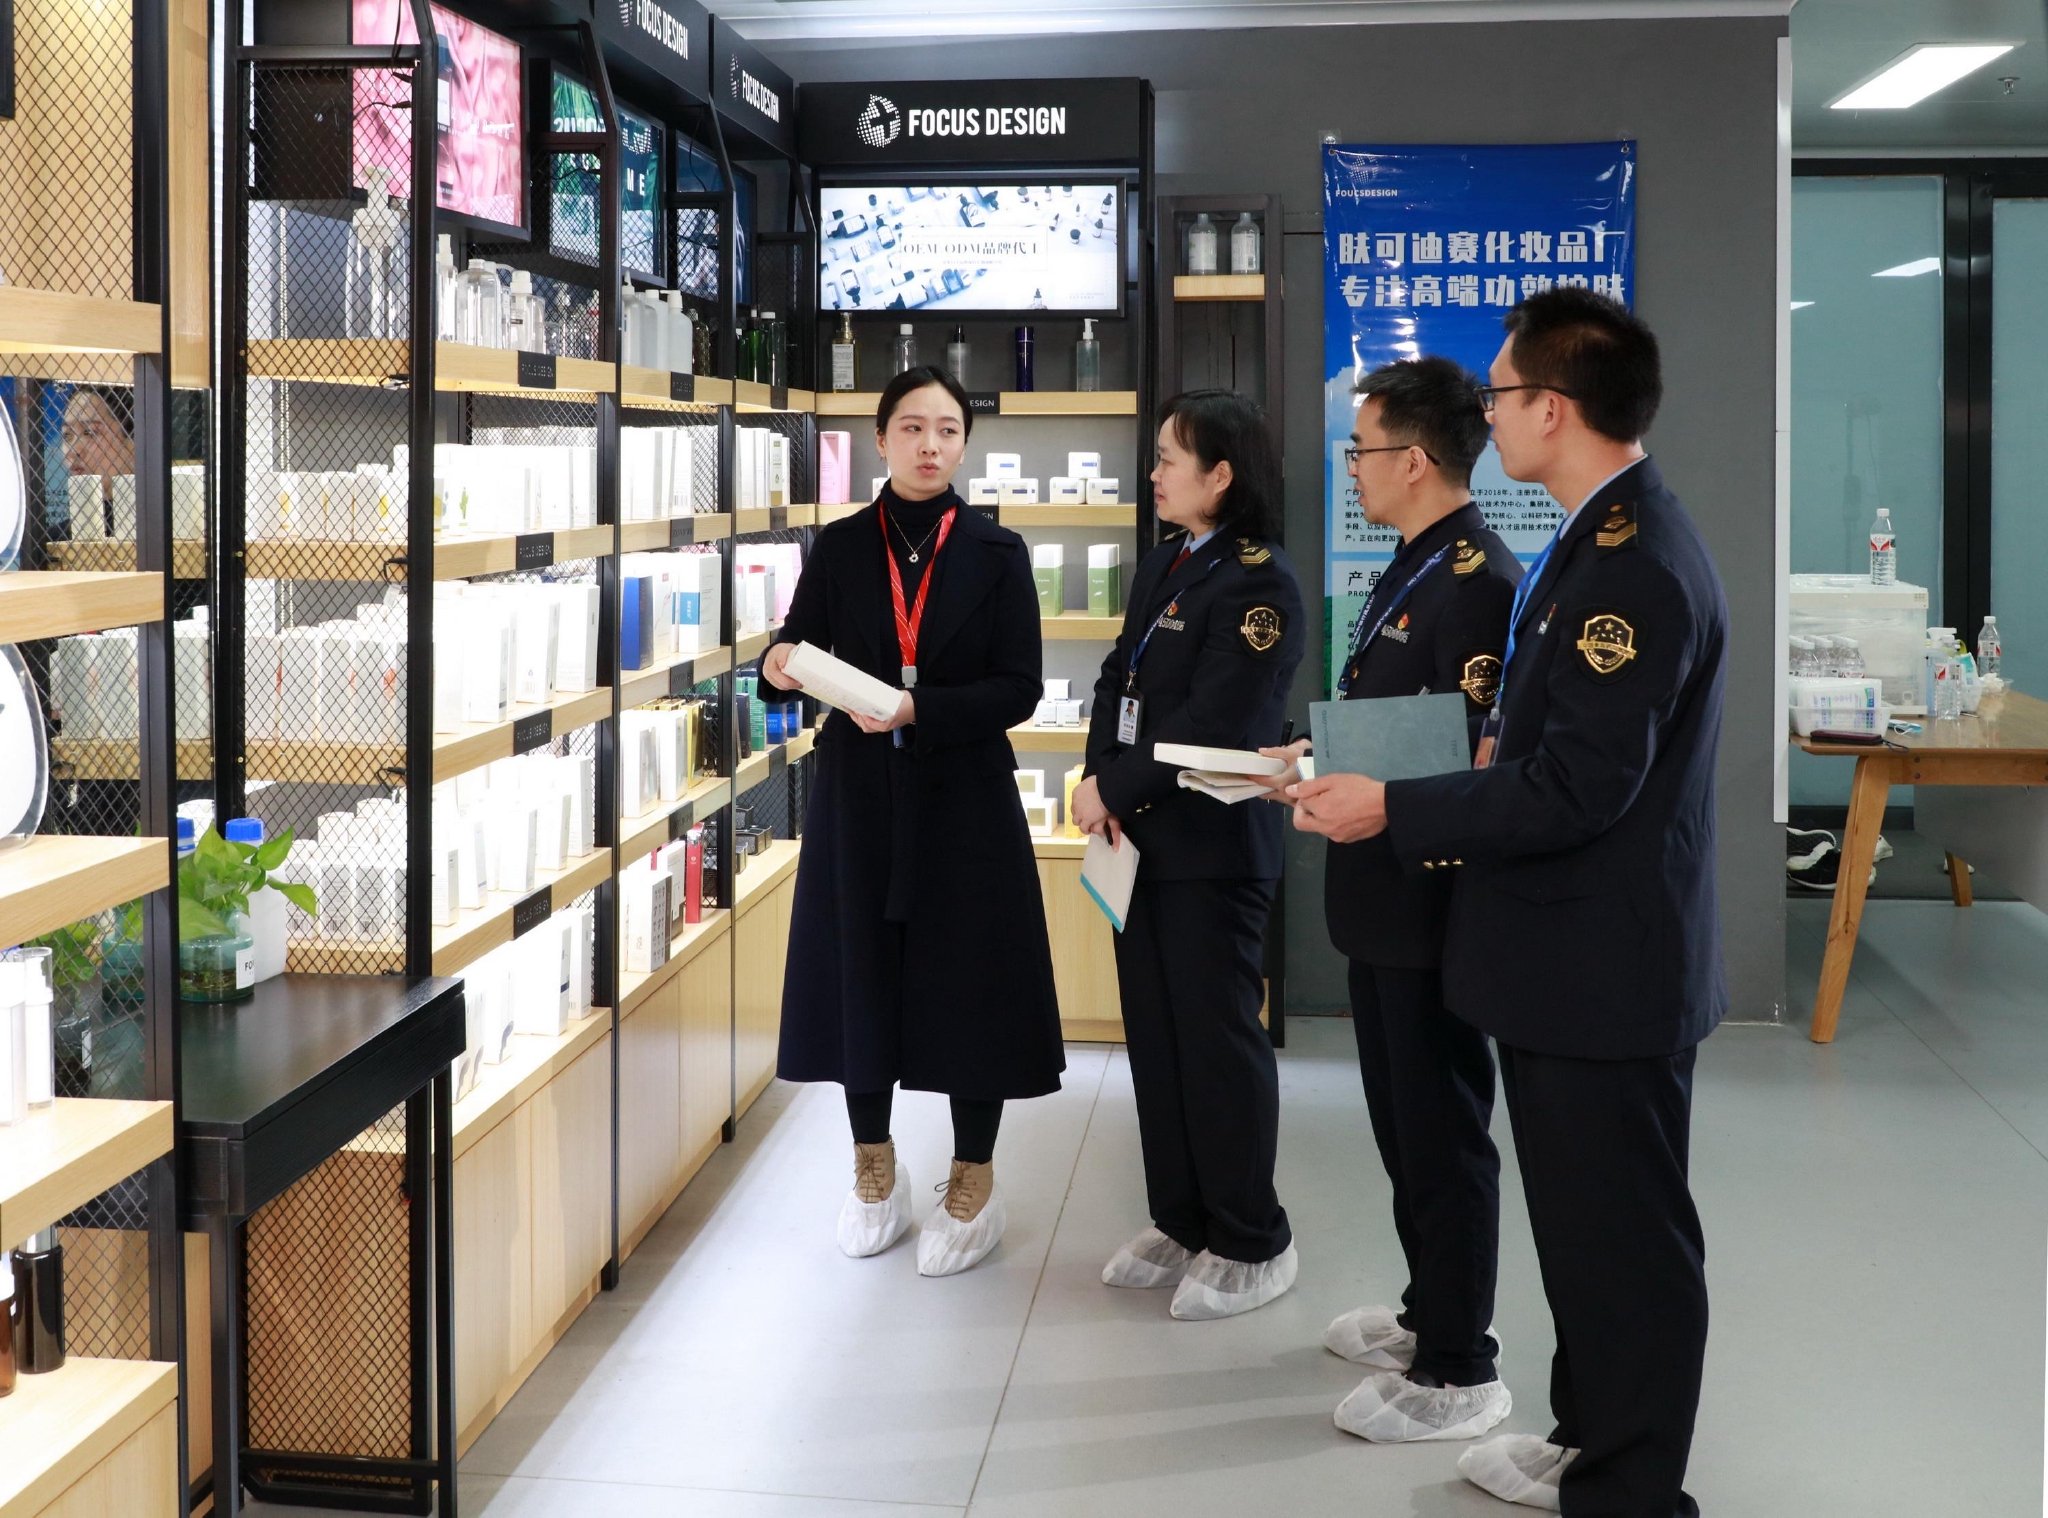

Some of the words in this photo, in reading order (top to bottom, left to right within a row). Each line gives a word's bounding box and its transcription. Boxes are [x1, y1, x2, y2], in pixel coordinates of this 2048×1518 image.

[636, 0, 662, 41] FOCUS
[662, 10, 689, 61] DESIGN
[742, 69, 761, 110] FOCUS
[760, 83, 780, 124] DESIGN
[908, 108, 981, 137] FOCUS
[985, 107, 1067, 136] DESIGN
[1335, 189, 1398, 197] FOUCSDESIGN
[1339, 230, 1626, 264] 肤可迪赛化妆品厂
[969, 399, 995, 407] ESIGN
[1481, 512, 1565, 520] 客为核心、以科研为重点
